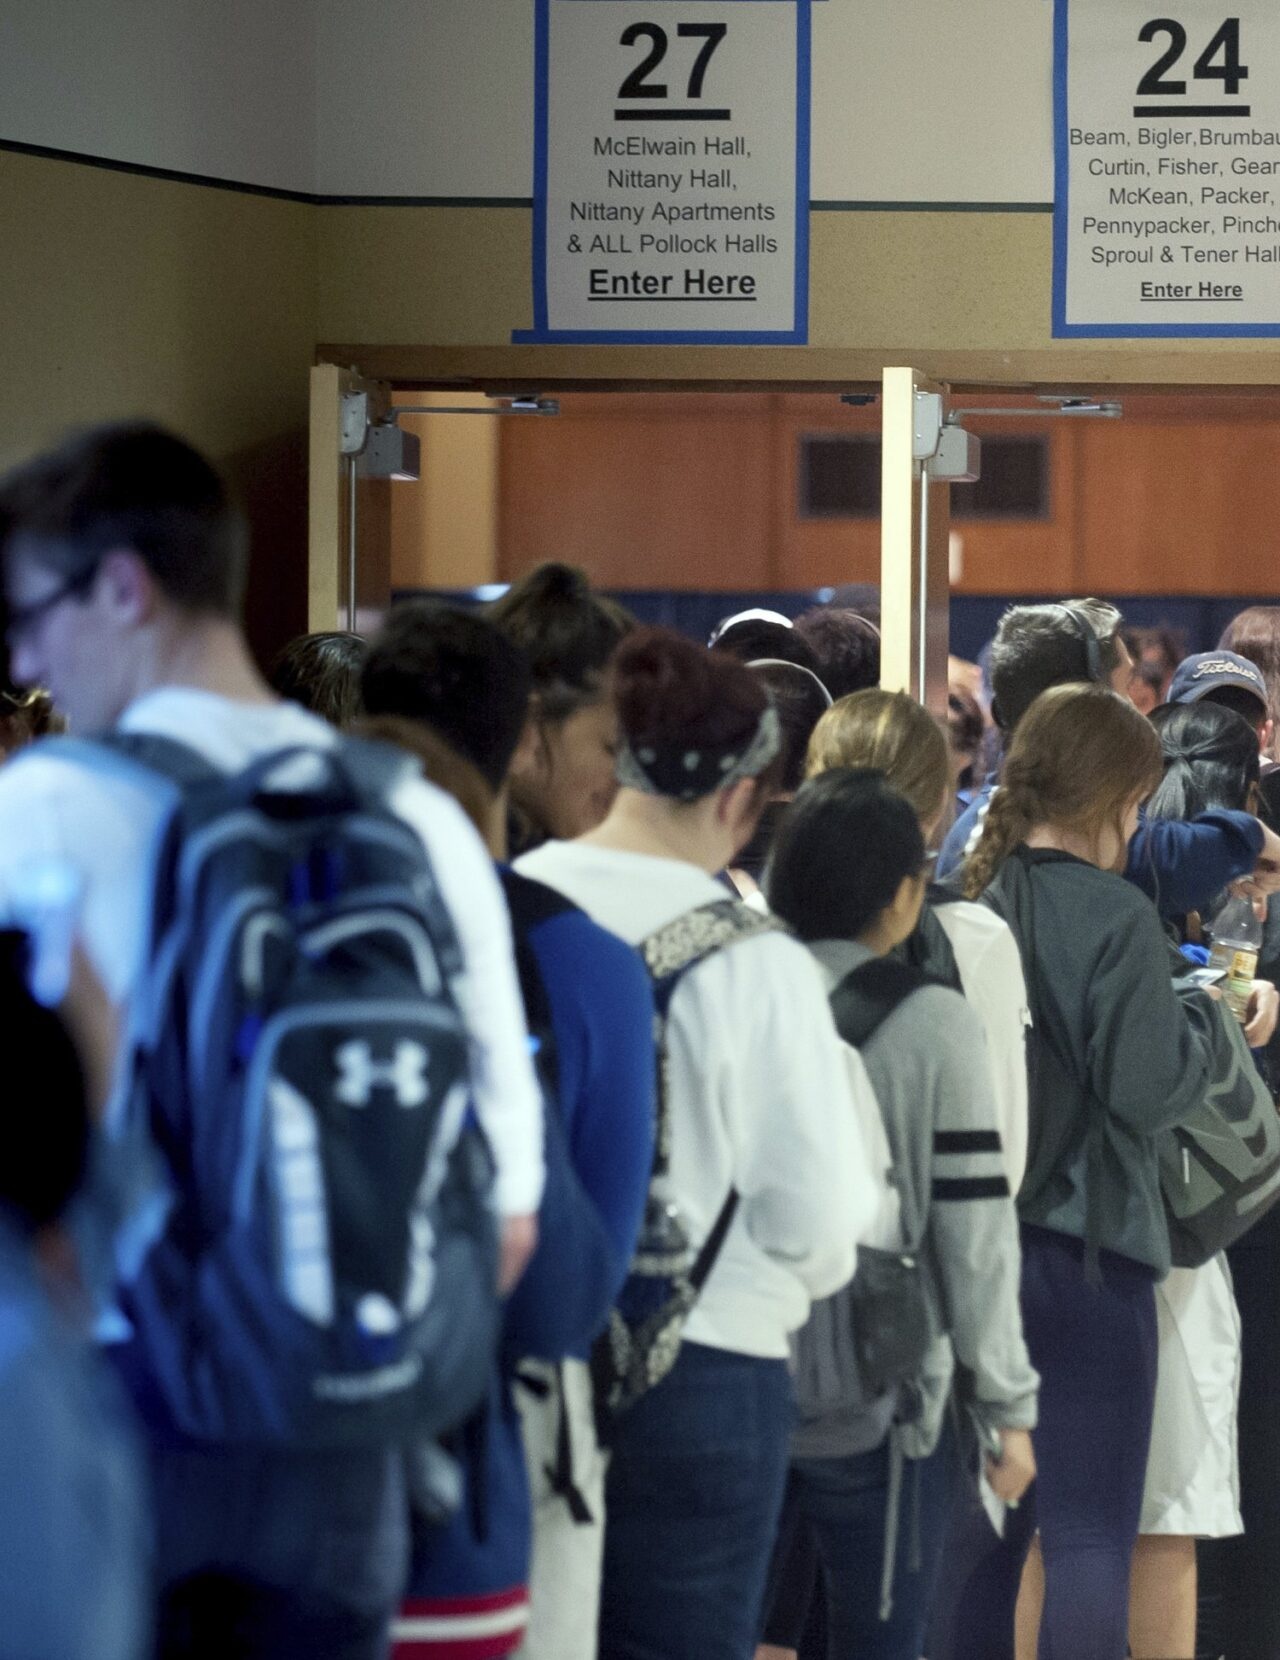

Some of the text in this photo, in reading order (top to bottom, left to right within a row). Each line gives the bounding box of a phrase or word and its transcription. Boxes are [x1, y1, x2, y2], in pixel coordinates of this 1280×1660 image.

[616, 21, 728, 100] 27
[1135, 17, 1249, 96] 24
[592, 135, 751, 159] McElwain Hall,
[1069, 127, 1131, 148] Beam,
[1088, 157, 1151, 178] Curtin,
[1157, 157, 1224, 178] Fisher,
[607, 168, 737, 194] Nittany Hall,
[1108, 186, 1275, 207] McKean, Packer,
[569, 200, 776, 227] Nittany Apartments
[1082, 216, 1216, 239] Pennypacker,
[566, 233, 778, 254] & ALL Pollock Halls
[1090, 245, 1154, 268] Sproul
[1159, 245, 1175, 264] &
[1180, 245, 1240, 264] Tener
[589, 268, 756, 295] Enter Here
[1139, 281, 1244, 299] Enter Here
